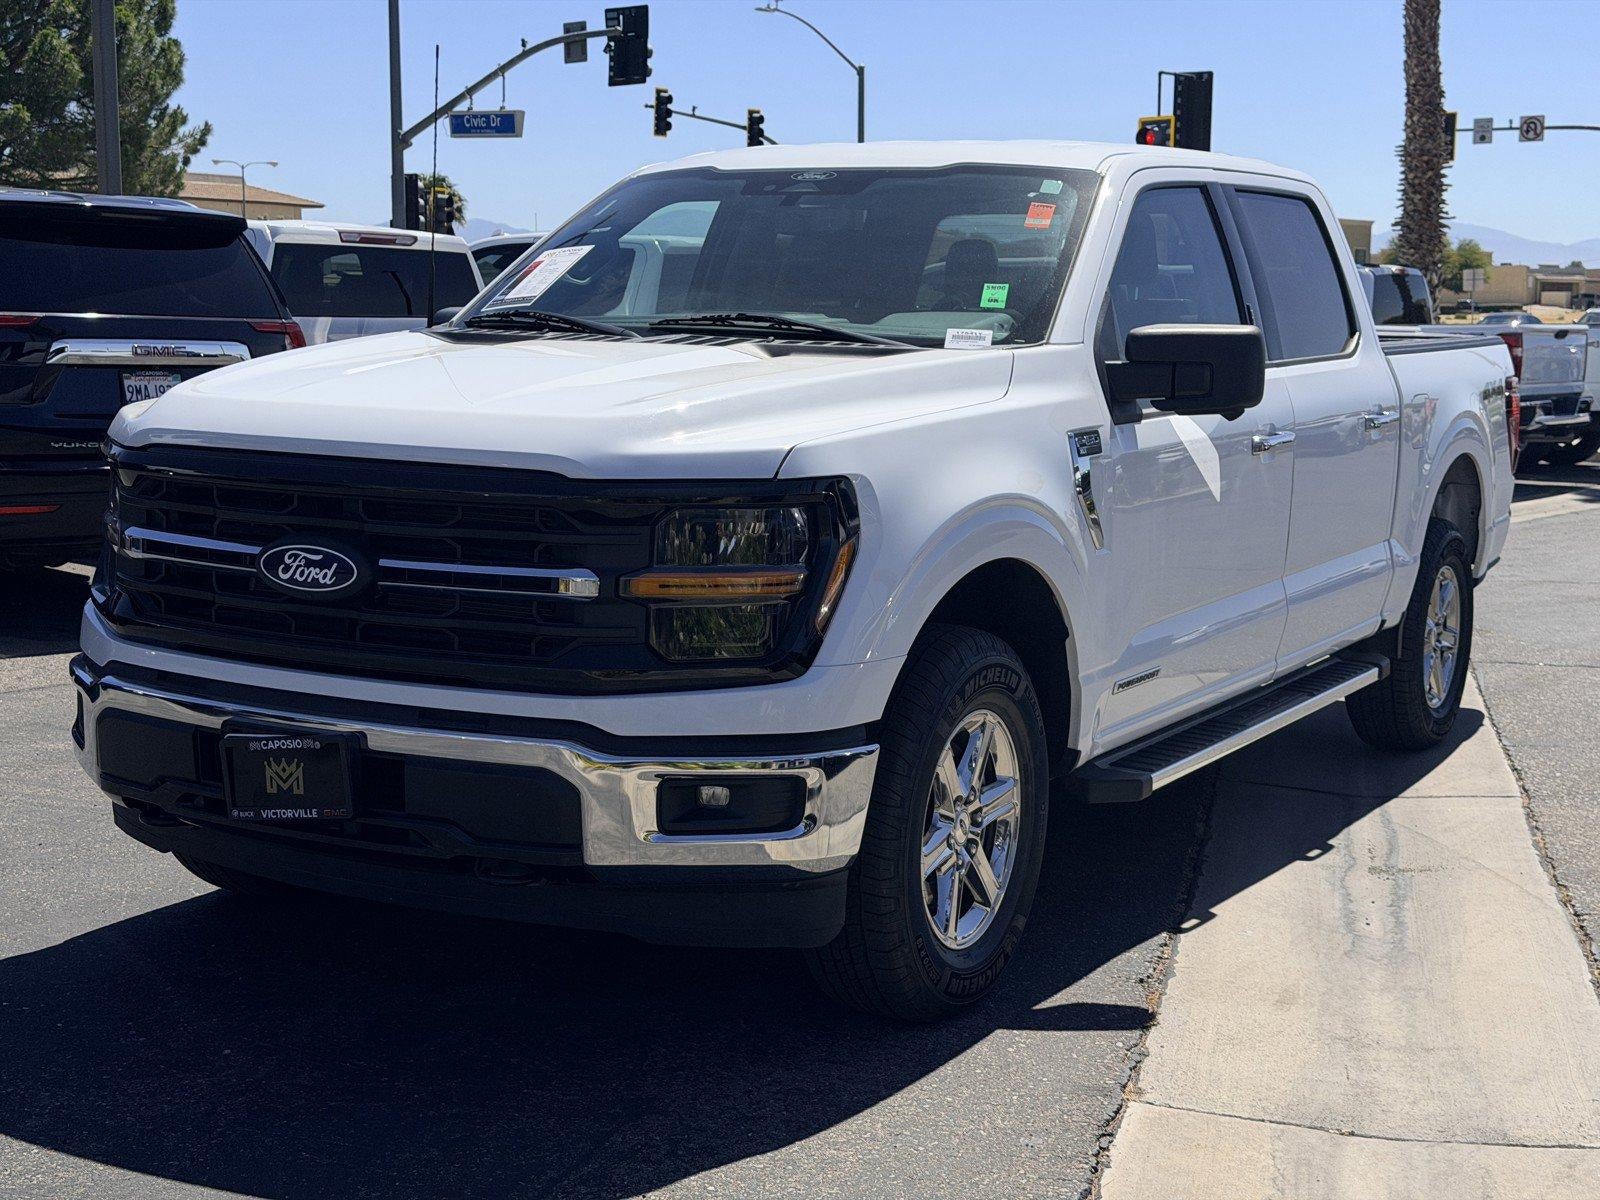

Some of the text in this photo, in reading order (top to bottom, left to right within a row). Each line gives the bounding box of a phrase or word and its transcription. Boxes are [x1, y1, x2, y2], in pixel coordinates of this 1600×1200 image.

[464, 114, 502, 127] Civic Dr
[132, 345, 187, 357] GMC
[278, 550, 338, 585] Ford
[964, 667, 1019, 701] MICHELIN
[260, 739, 303, 749] CAPOSIO
[260, 808, 318, 818] VICTORVILLE
